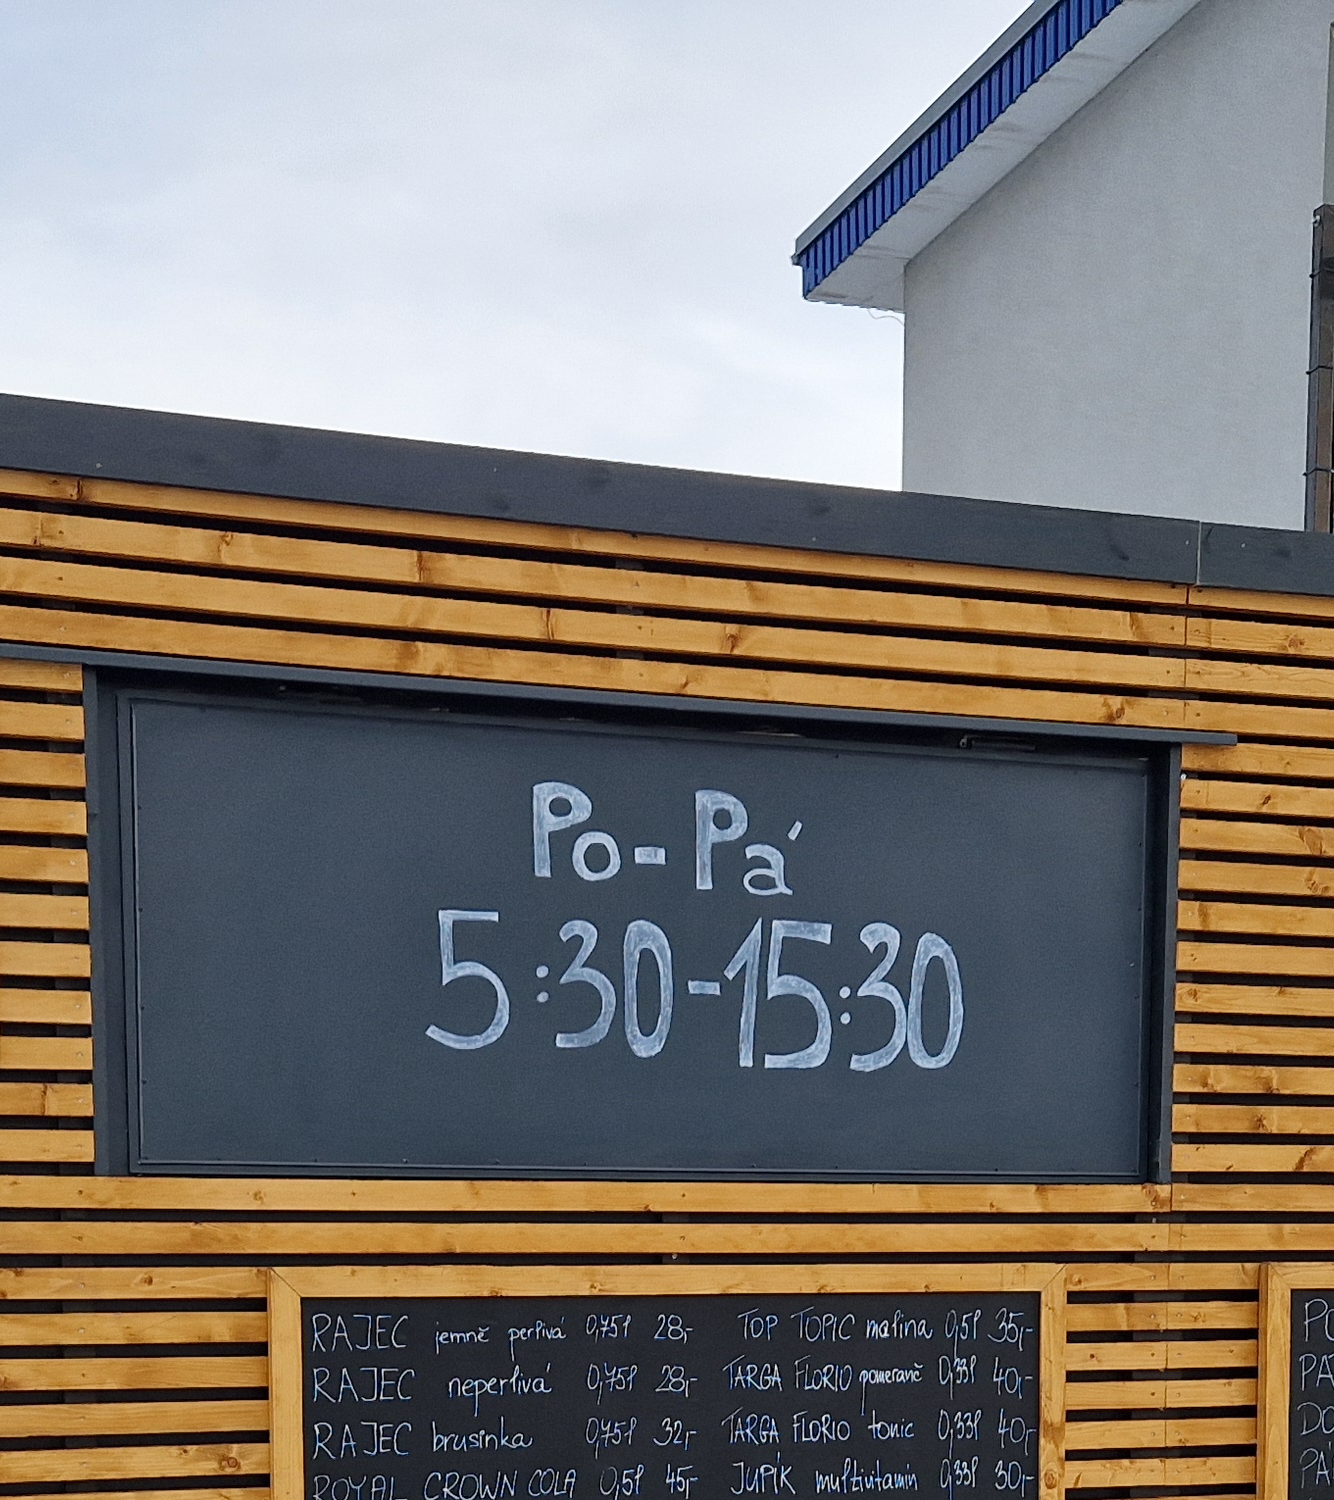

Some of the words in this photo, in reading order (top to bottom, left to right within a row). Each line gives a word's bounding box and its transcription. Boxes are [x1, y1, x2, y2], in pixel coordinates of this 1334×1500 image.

[311, 1313, 409, 1352] RAJEC
[435, 1321, 490, 1354] jemně
[508, 1316, 566, 1361] perlivá
[654, 1313, 694, 1344] 28,-
[737, 1308, 779, 1341] TOP
[790, 1306, 856, 1342] TOPIC
[866, 1309, 933, 1340] malina
[987, 1307, 1034, 1351] 35,-
[312, 1366, 416, 1402] RAJEC
[448, 1361, 553, 1417] neperlivá
[655, 1365, 698, 1398] 28,-
[723, 1354, 782, 1391] TARGA
[795, 1355, 852, 1391] FLORIO
[859, 1362, 924, 1416] pomeranč
[993, 1357, 1034, 1399] 40,-
[312, 1421, 412, 1460] RAJEC
[432, 1416, 533, 1453] brusinka
[653, 1417, 698, 1451] 32,-
[721, 1407, 779, 1445] TARGA
[793, 1411, 851, 1443] FLORIO
[868, 1409, 915, 1440] tonic
[423, 1470, 518, 1500] CROWN
[528, 1468, 578, 1498] COLA
[665, 1463, 698, 1499] 45,-
[731, 1451, 796, 1495] JUPÍK
[816, 1457, 919, 1495] multivitamin
[995, 1458, 1035, 1497] 30,-
